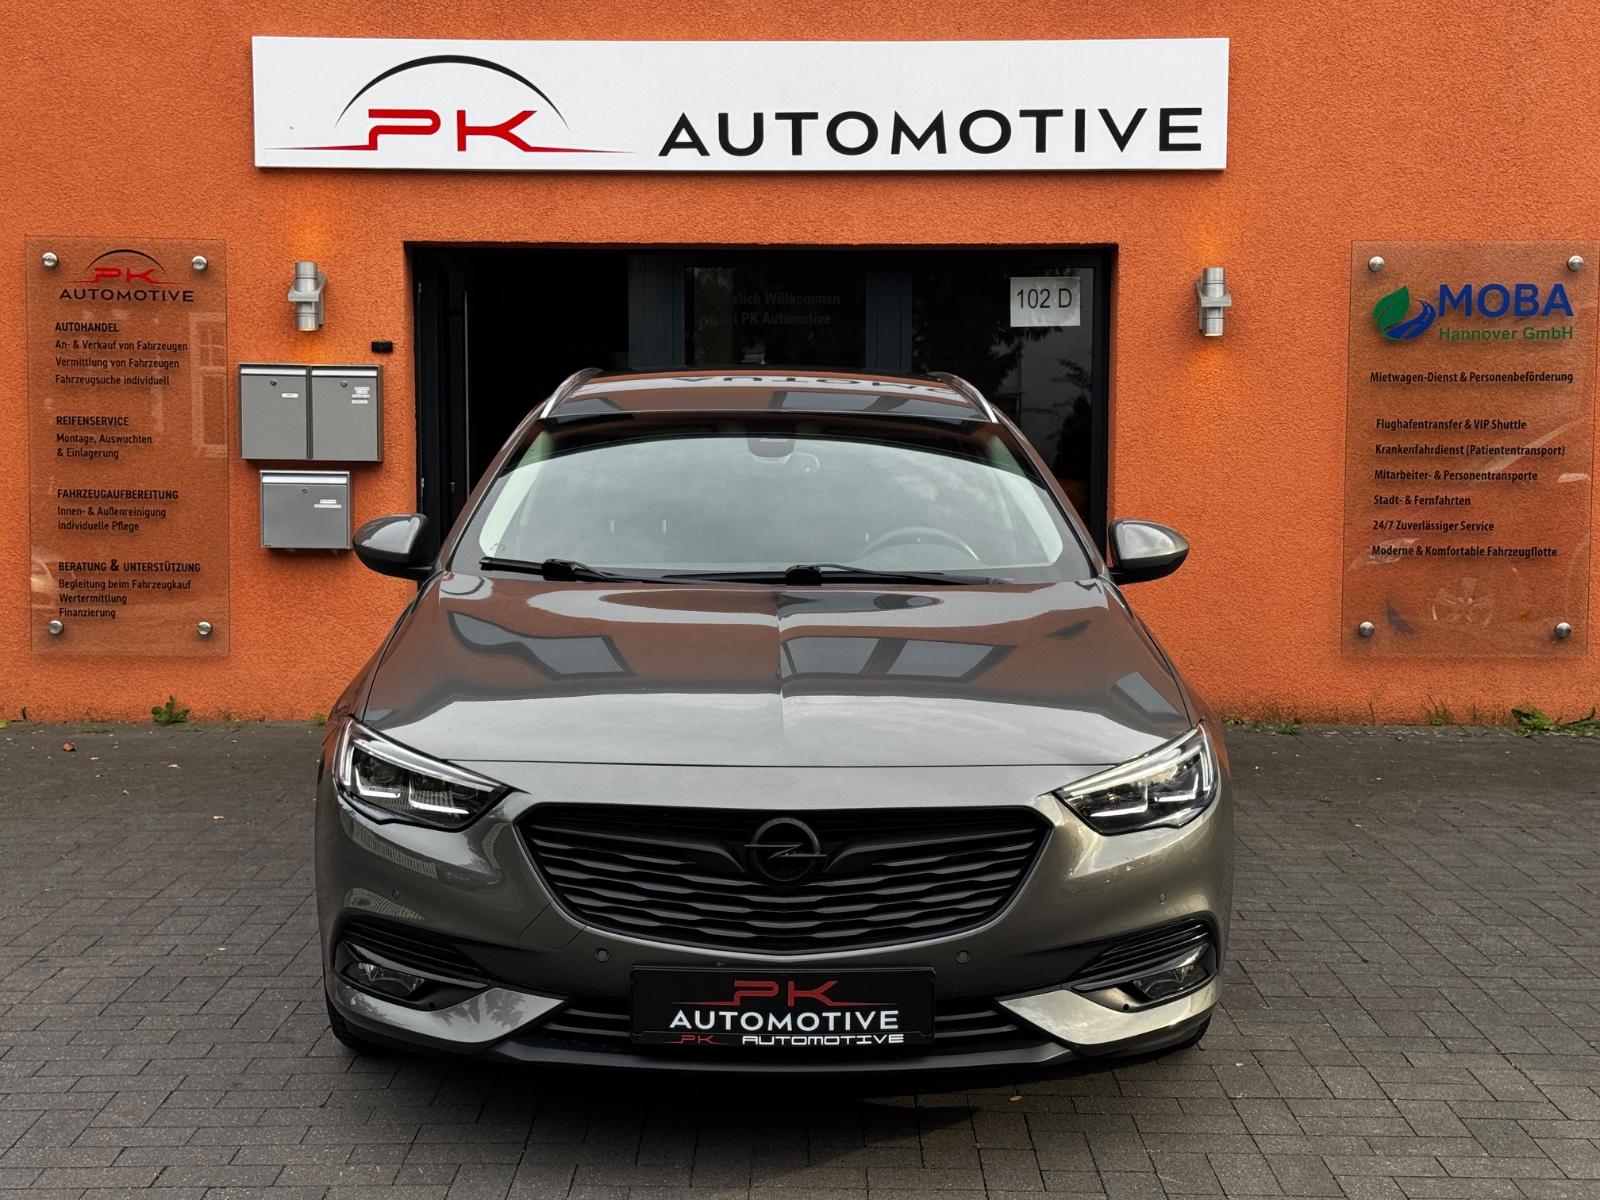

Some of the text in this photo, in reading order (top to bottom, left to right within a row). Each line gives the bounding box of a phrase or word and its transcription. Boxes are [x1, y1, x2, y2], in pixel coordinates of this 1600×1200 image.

[368, 107, 1202, 157] PK AUTOMOTIVE
[59, 288, 194, 302] AUTOMOTIVE
[764, 292, 840, 305] Willkommen
[1016, 288, 1072, 309] 102 D
[1438, 283, 1574, 318] MOBA
[742, 312, 759, 325] PK
[761, 312, 831, 325] Automotive
[55, 322, 119, 333] AUTOHANDEL
[1439, 327, 1573, 341] Hannover GmbH
[55, 340, 188, 352] An- & Verkauf von Fahrzeugen
[56, 357, 180, 369] Vermittlung von Fahrzeugen
[55, 374, 170, 387] Fahrzeugsuche individuell
[1370, 371, 1574, 384] Mietwagen-Dienst & Personenbeförderung
[56, 416, 129, 426] REIFENSERVICE
[1376, 418, 1527, 431] Flughafentransfer & VIP Shuttle
[56, 433, 152, 445] Montage, Auswuchten
[57, 448, 119, 459] & Einlagerung
[1375, 444, 1565, 457] Krankenfahrdienst (Patiententransport)
[1374, 470, 1538, 482] Mitarbeiter- & Personentransporte
[57, 489, 179, 500] FAHRZEUGAUFBEREITUNG
[1373, 495, 1471, 506] Stadt- & Fernfahrten
[58, 507, 167, 518] Innen- & Außenreinigung
[58, 521, 139, 533] Individuelle Pflege
[1372, 520, 1494, 533] 24/7 Zuverlässiger Service
[1372, 545, 1558, 558] Moderne & Komfortable Fahrzeugflotte
[58, 559, 201, 573] BERATUNG & UNTERSTÜTZUNG
[59, 579, 191, 591] Begleitung beim Fahrzeugkauf
[59, 593, 127, 605] Wertermittlung
[59, 608, 116, 619] Finanzierung
[669, 1010, 899, 1031] AUTOMOTIVE
[742, 1034, 904, 1045] AUTOMOTIVE
